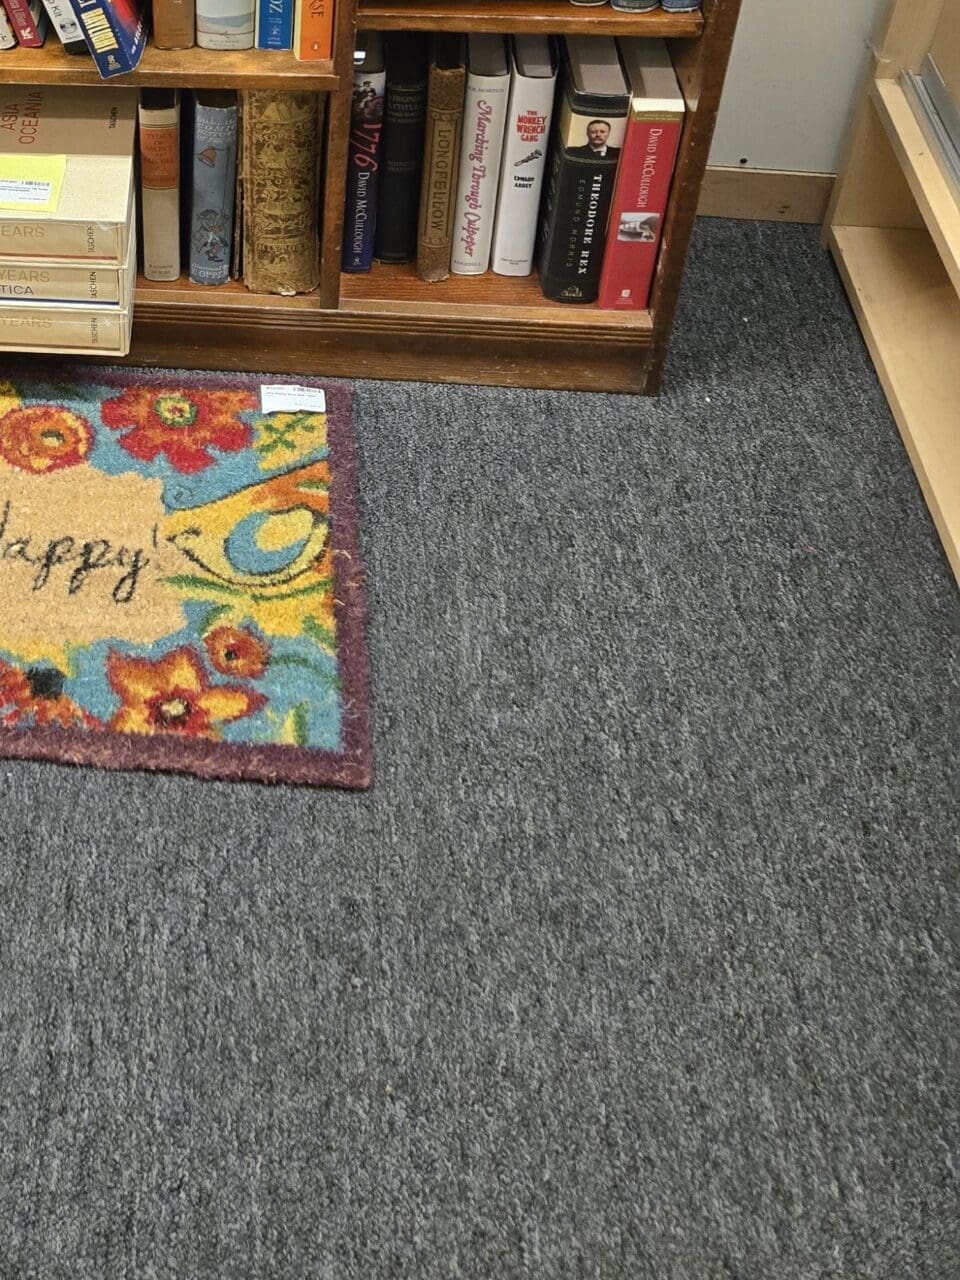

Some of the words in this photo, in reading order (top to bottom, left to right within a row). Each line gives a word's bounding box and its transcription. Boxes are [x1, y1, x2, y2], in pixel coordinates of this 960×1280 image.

[52, 2, 63, 18] Kit
[0, 102, 20, 132] ASIA
[18, 90, 44, 145] OCEANIA
[468, 99, 494, 166] Marching
[516, 124, 546, 135] WRENCH
[517, 114, 546, 128] MONKEY
[520, 134, 539, 143] GANG
[352, 120, 384, 172] 1776
[646, 128, 663, 154] DAVID
[356, 171, 370, 201] DAVID
[432, 128, 451, 233] LONGFELLOW
[464, 165, 487, 212] Through
[636, 154, 657, 209] McCULLOUGH
[352, 200, 370, 256] McCULLOUGH
[460, 208, 483, 258] Culpeper
[584, 174, 604, 248] THEODORE
[578, 248, 593, 275] REX
